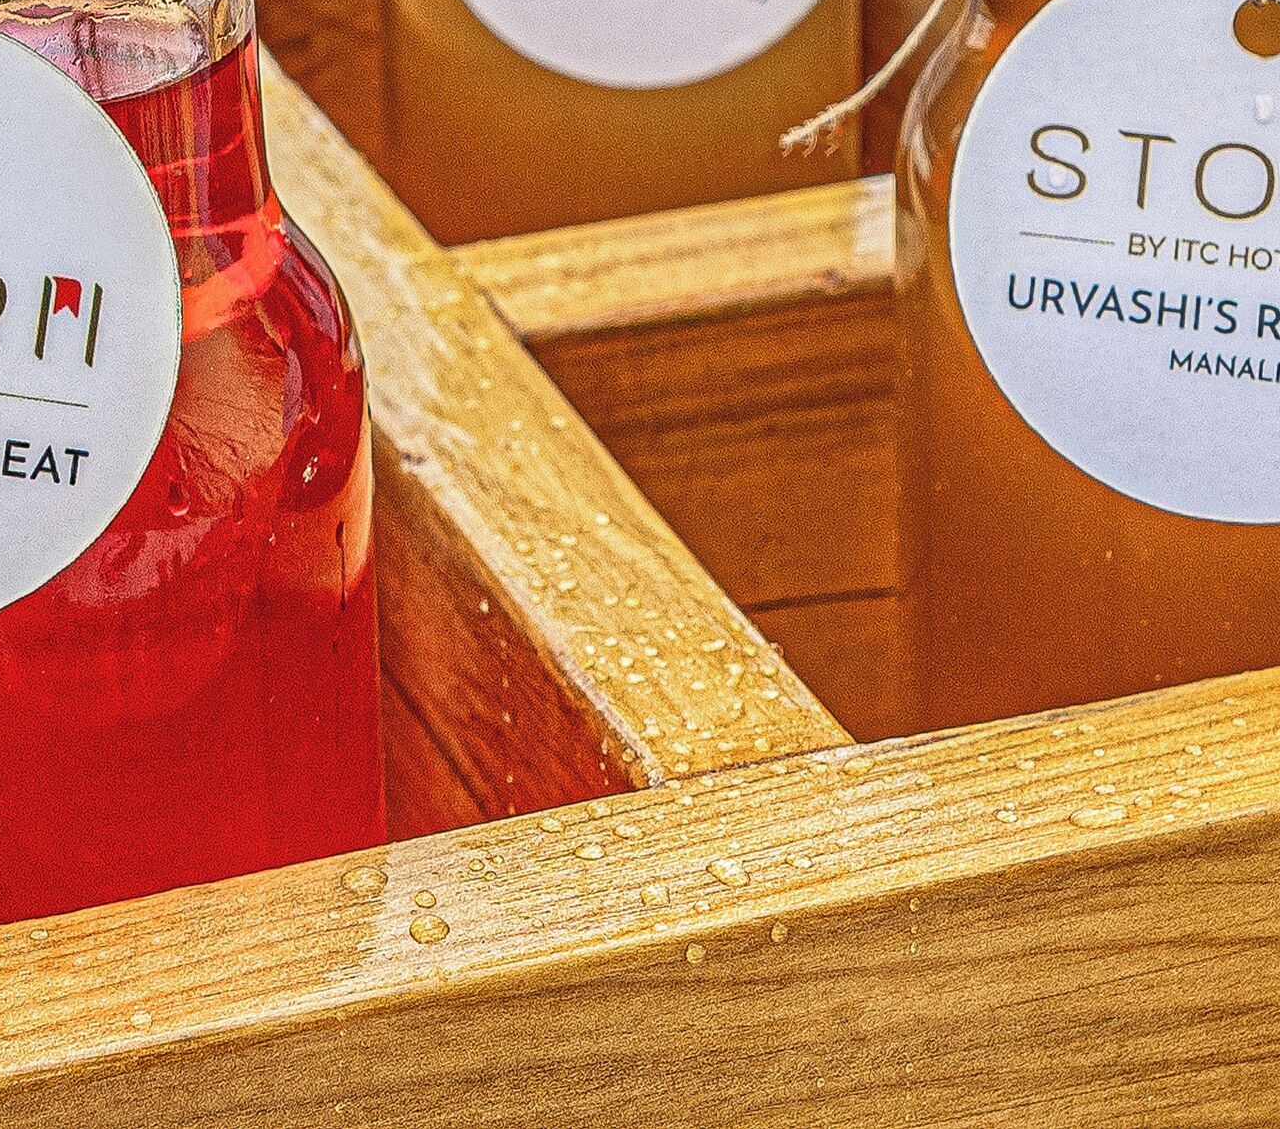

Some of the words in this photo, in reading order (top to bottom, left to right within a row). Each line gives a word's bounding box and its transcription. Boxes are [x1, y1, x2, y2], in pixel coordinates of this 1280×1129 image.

[1128, 233, 1167, 259] BY
[1173, 238, 1220, 266] ITC
[1006, 273, 1238, 335] URVASHI'S
